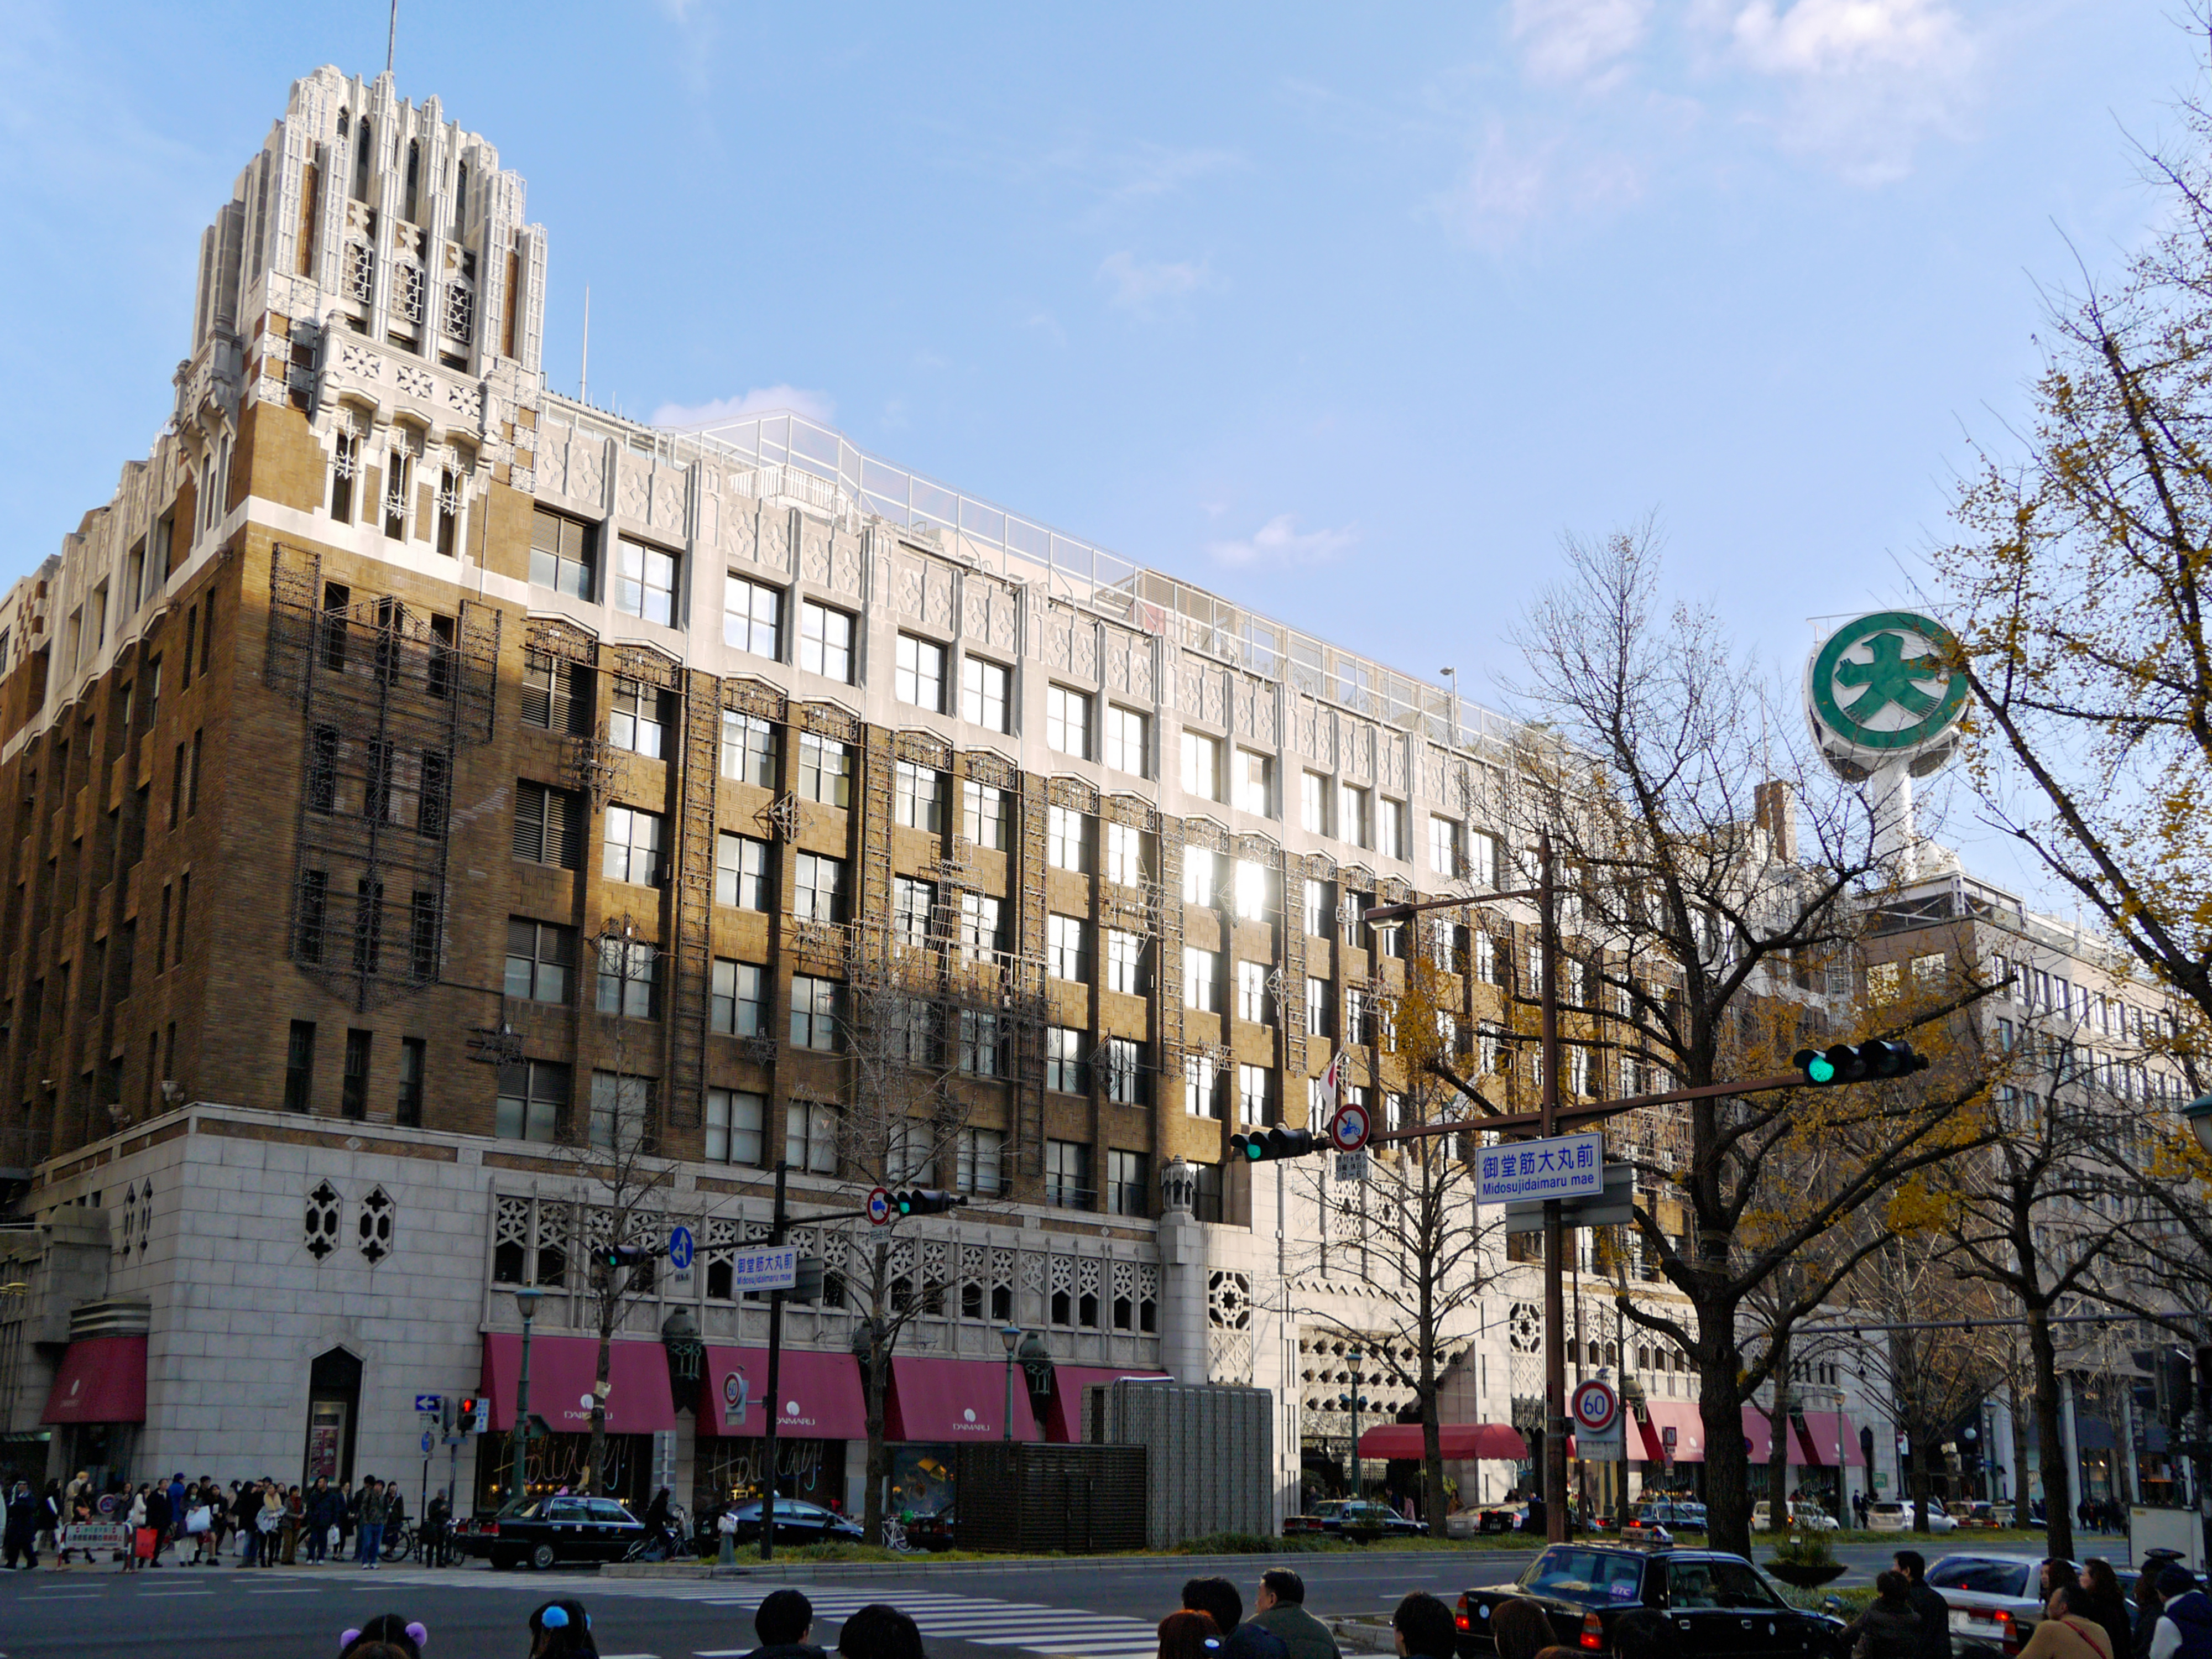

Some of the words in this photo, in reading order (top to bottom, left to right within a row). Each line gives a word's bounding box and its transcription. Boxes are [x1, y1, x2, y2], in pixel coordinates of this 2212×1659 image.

[1483, 1143, 1593, 1180] 御堂筋大丸前
[1483, 1176, 1567, 1196] Midosujidaimaru
[1571, 1174, 1594, 1186] mae
[737, 1253, 792, 1274] 御堂筋大丸前
[736, 1274, 779, 1285] Midosujidaimaru
[780, 1273, 792, 1281] mae
[728, 1383, 737, 1396] 60
[1584, 1395, 1605, 1415] 60
[953, 1423, 990, 1431] DAIMARU
[1611, 1585, 1632, 1596] ETC
